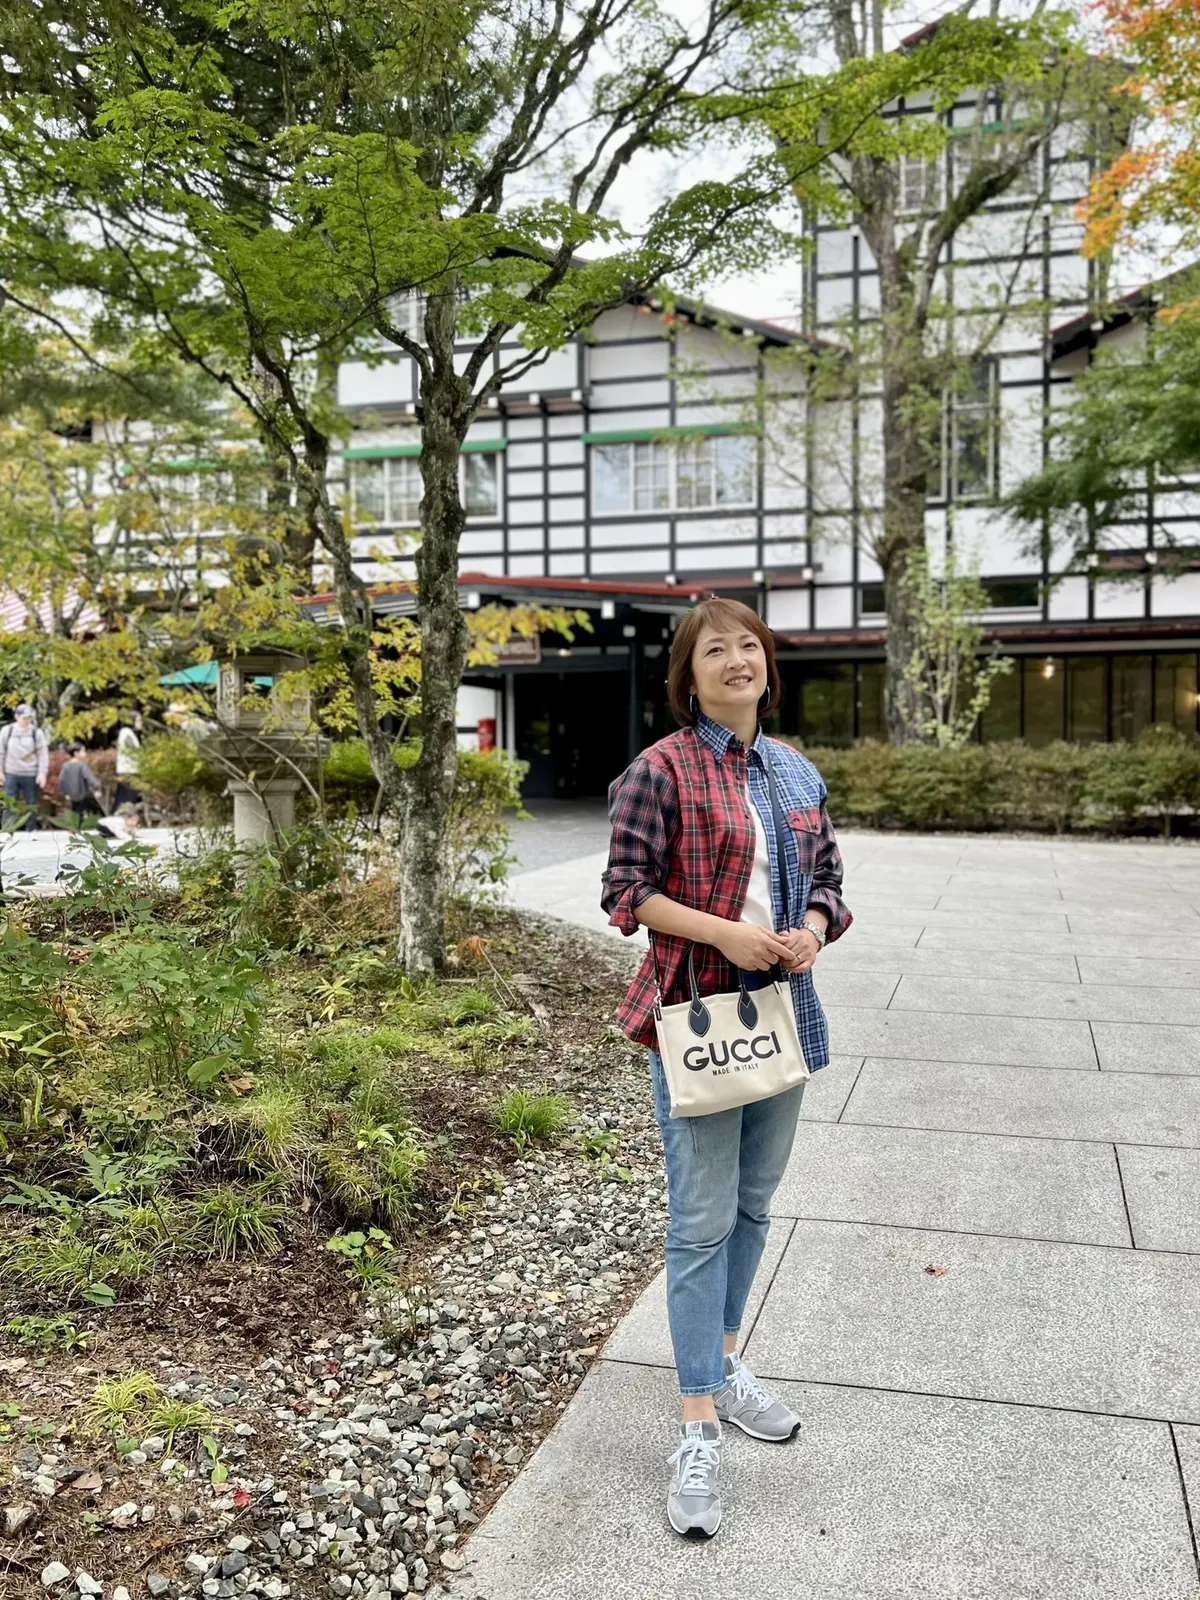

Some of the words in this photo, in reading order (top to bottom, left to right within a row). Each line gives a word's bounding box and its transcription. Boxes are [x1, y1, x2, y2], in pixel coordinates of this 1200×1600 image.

[683, 1031, 782, 1071] GUCCI
[712, 1067, 730, 1076] MADE
[741, 1063, 759, 1071] ITALY
